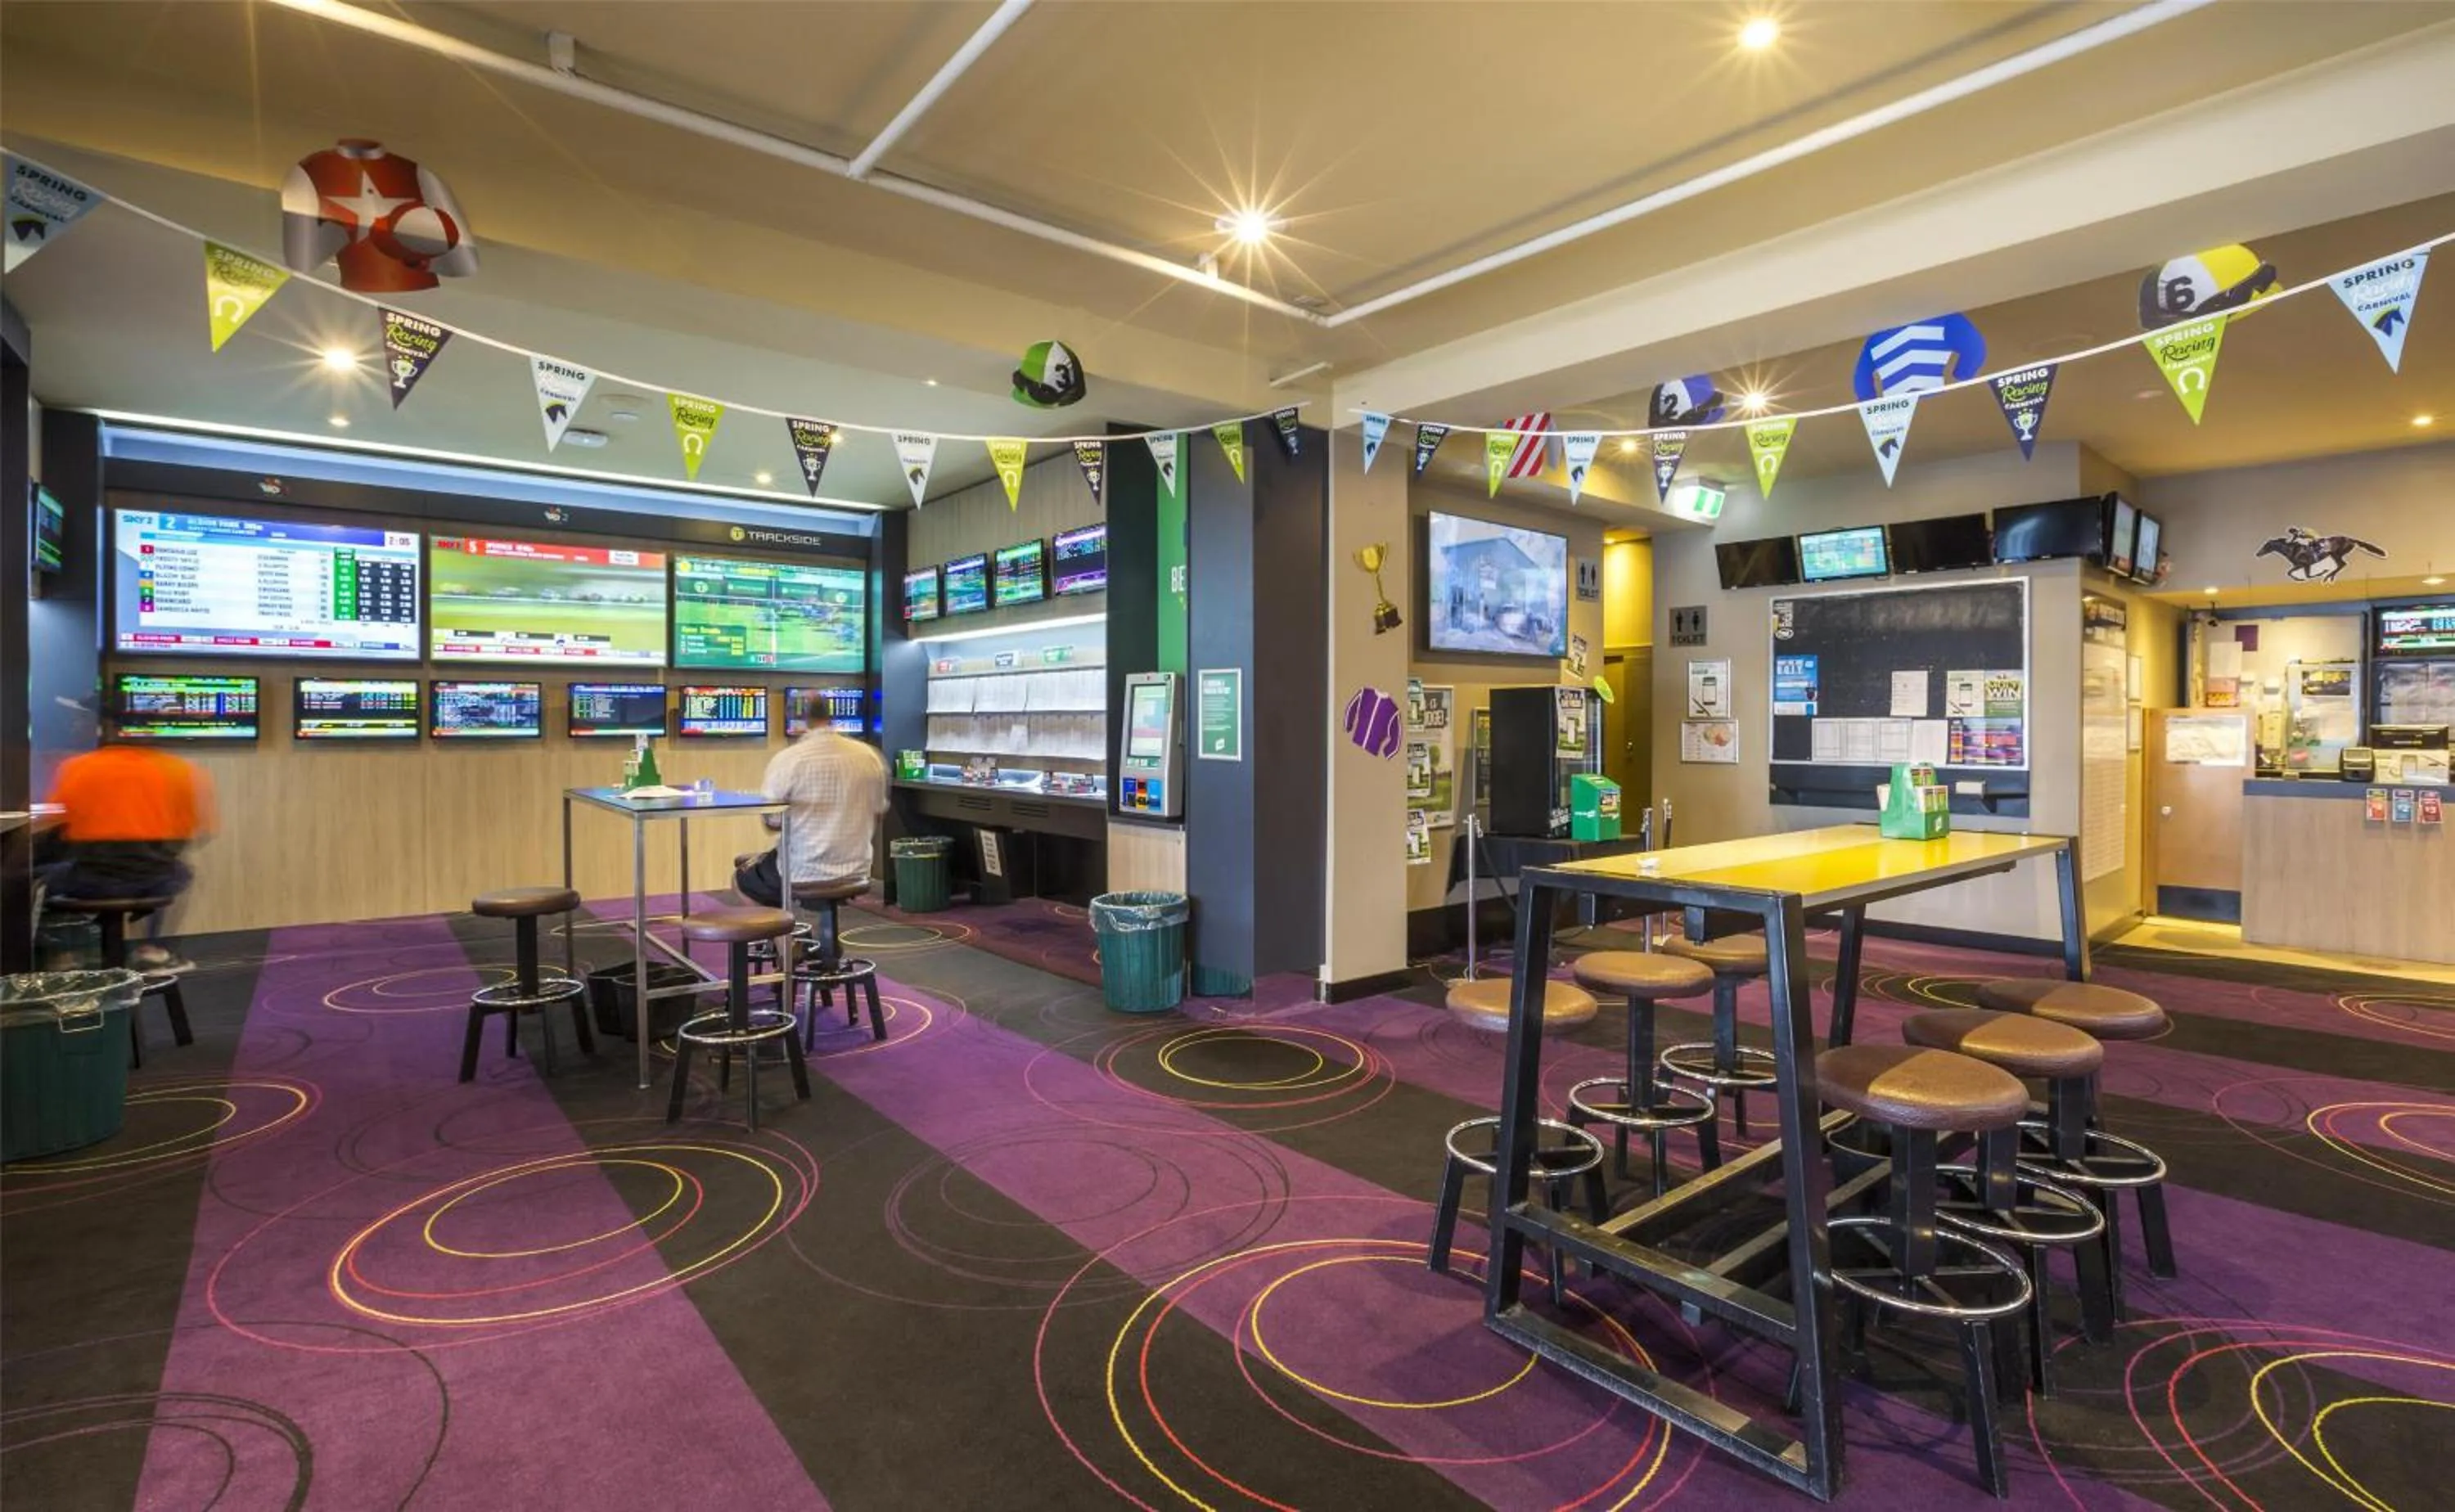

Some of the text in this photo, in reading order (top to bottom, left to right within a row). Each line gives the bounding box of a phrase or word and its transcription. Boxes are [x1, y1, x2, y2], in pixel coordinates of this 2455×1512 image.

[16, 164, 88, 202] SPRING
[2343, 258, 2416, 289] SPRING
[2164, 275, 2196, 311] 6
[2357, 292, 2411, 312] CARNIVAL
[386, 312, 441, 337] SPRING
[2155, 323, 2215, 348] SPRING
[386, 323, 437, 354] Racing
[2160, 336, 2216, 365] Racing
[538, 361, 586, 381] SPRING
[1054, 363, 1070, 389] 3
[1998, 367, 2048, 389] SPRING
[2001, 381, 2048, 404] Racing
[2004, 396, 2044, 410] CARNIVAL
[1664, 393, 1678, 416] 2
[1867, 398, 1910, 415] SPRING
[675, 406, 715, 430] Racing
[792, 419, 831, 434] SPRING
[896, 434, 931, 446] SPRING
[1653, 431, 1687, 442] SPRING
[747, 530, 822, 547] TRACKSIDE
[1672, 633, 1705, 644] TOILET
[1989, 688, 2020, 701] WIN
